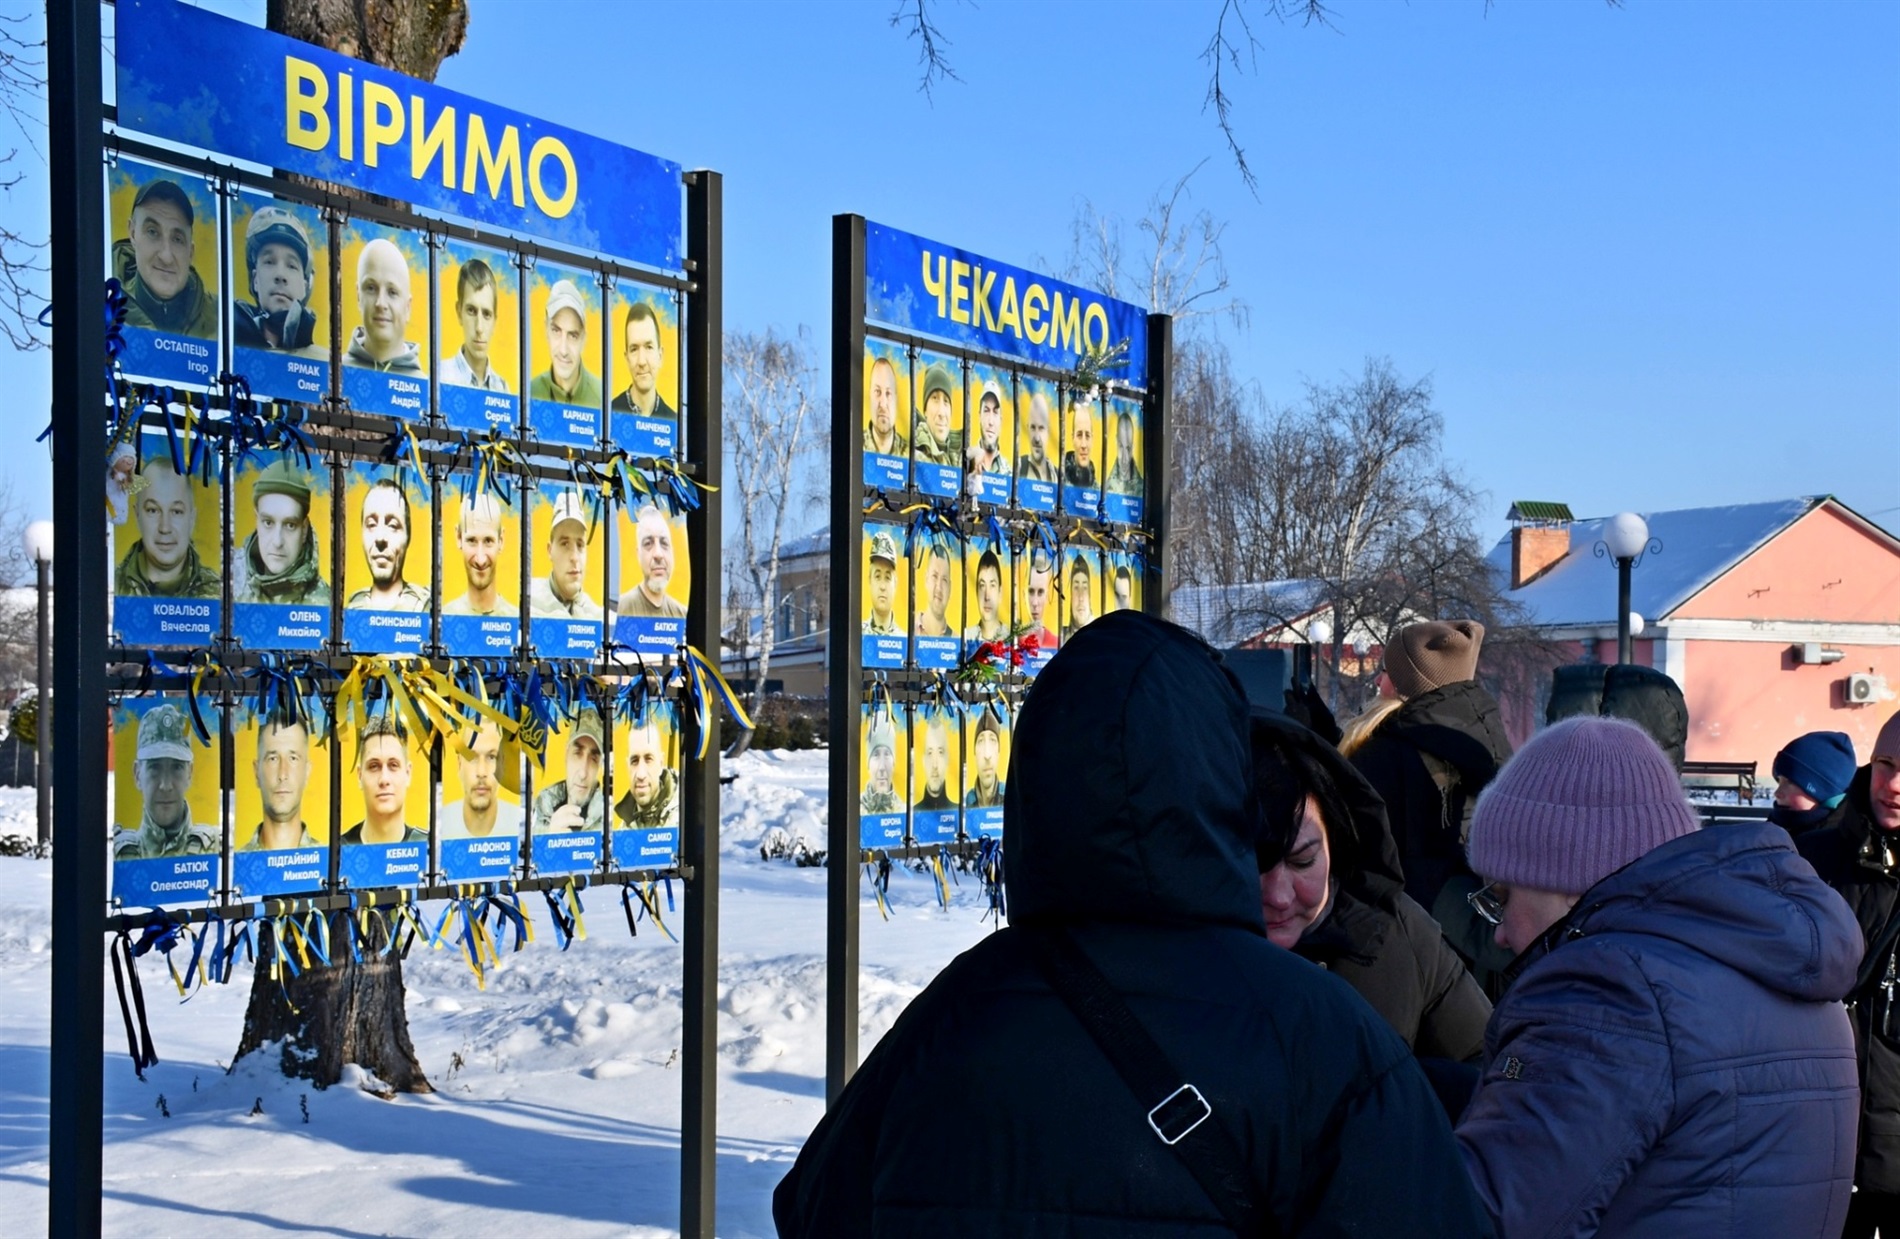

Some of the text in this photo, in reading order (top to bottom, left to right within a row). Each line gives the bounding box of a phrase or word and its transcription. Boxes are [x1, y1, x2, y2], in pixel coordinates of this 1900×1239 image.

[285, 55, 578, 219] ВІРИМО
[922, 250, 1109, 355] ЧЕКАЄМО
[154, 338, 209, 358] ОСТАПЕЦЬ
[188, 360, 209, 375] Ігор
[287, 362, 320, 377] ЯРМАК
[297, 379, 320, 393] Олег
[388, 379, 421, 394] РЕДЬКА
[391, 394, 421, 409] Андрій
[484, 396, 511, 409] ЛИЧАК
[485, 410, 511, 423] Сергій
[563, 409, 595, 422] КАРНАУХ
[569, 423, 595, 436] Віталій
[636, 421, 671, 434] ПАНЧЕНКО
[653, 436, 671, 448] Юрій
[153, 604, 210, 617] КОВАЛЬОВ
[289, 611, 321, 622] ОЛЕНЬ
[161, 620, 210, 633] Вячеслав
[369, 615, 422, 628] ЯСИНСЬКИЙ
[481, 621, 512, 632] МІНЬКО
[654, 622, 678, 632] БАТЮК
[278, 626, 321, 638] Михайло
[394, 631, 422, 643] Денис
[486, 634, 512, 647] Сергій
[567, 638, 596, 649] Дмитро
[638, 634, 677, 646] Олександр
[548, 836, 596, 848] ПАРХОМЕНКО
[647, 832, 672, 843] САМКО
[386, 847, 419, 859] КЕБКАЛ
[468, 841, 511, 853] АГАФОНОВ
[640, 846, 672, 856] Валентин
[267, 851, 320, 868] ПІДГАЙНИЙ
[480, 855, 511, 867] Олексій
[572, 850, 595, 861] Віктор
[174, 860, 209, 874] БАТЮК
[385, 863, 419, 875] Данило
[282, 869, 320, 882] Микола
[151, 878, 209, 893] Олександр
